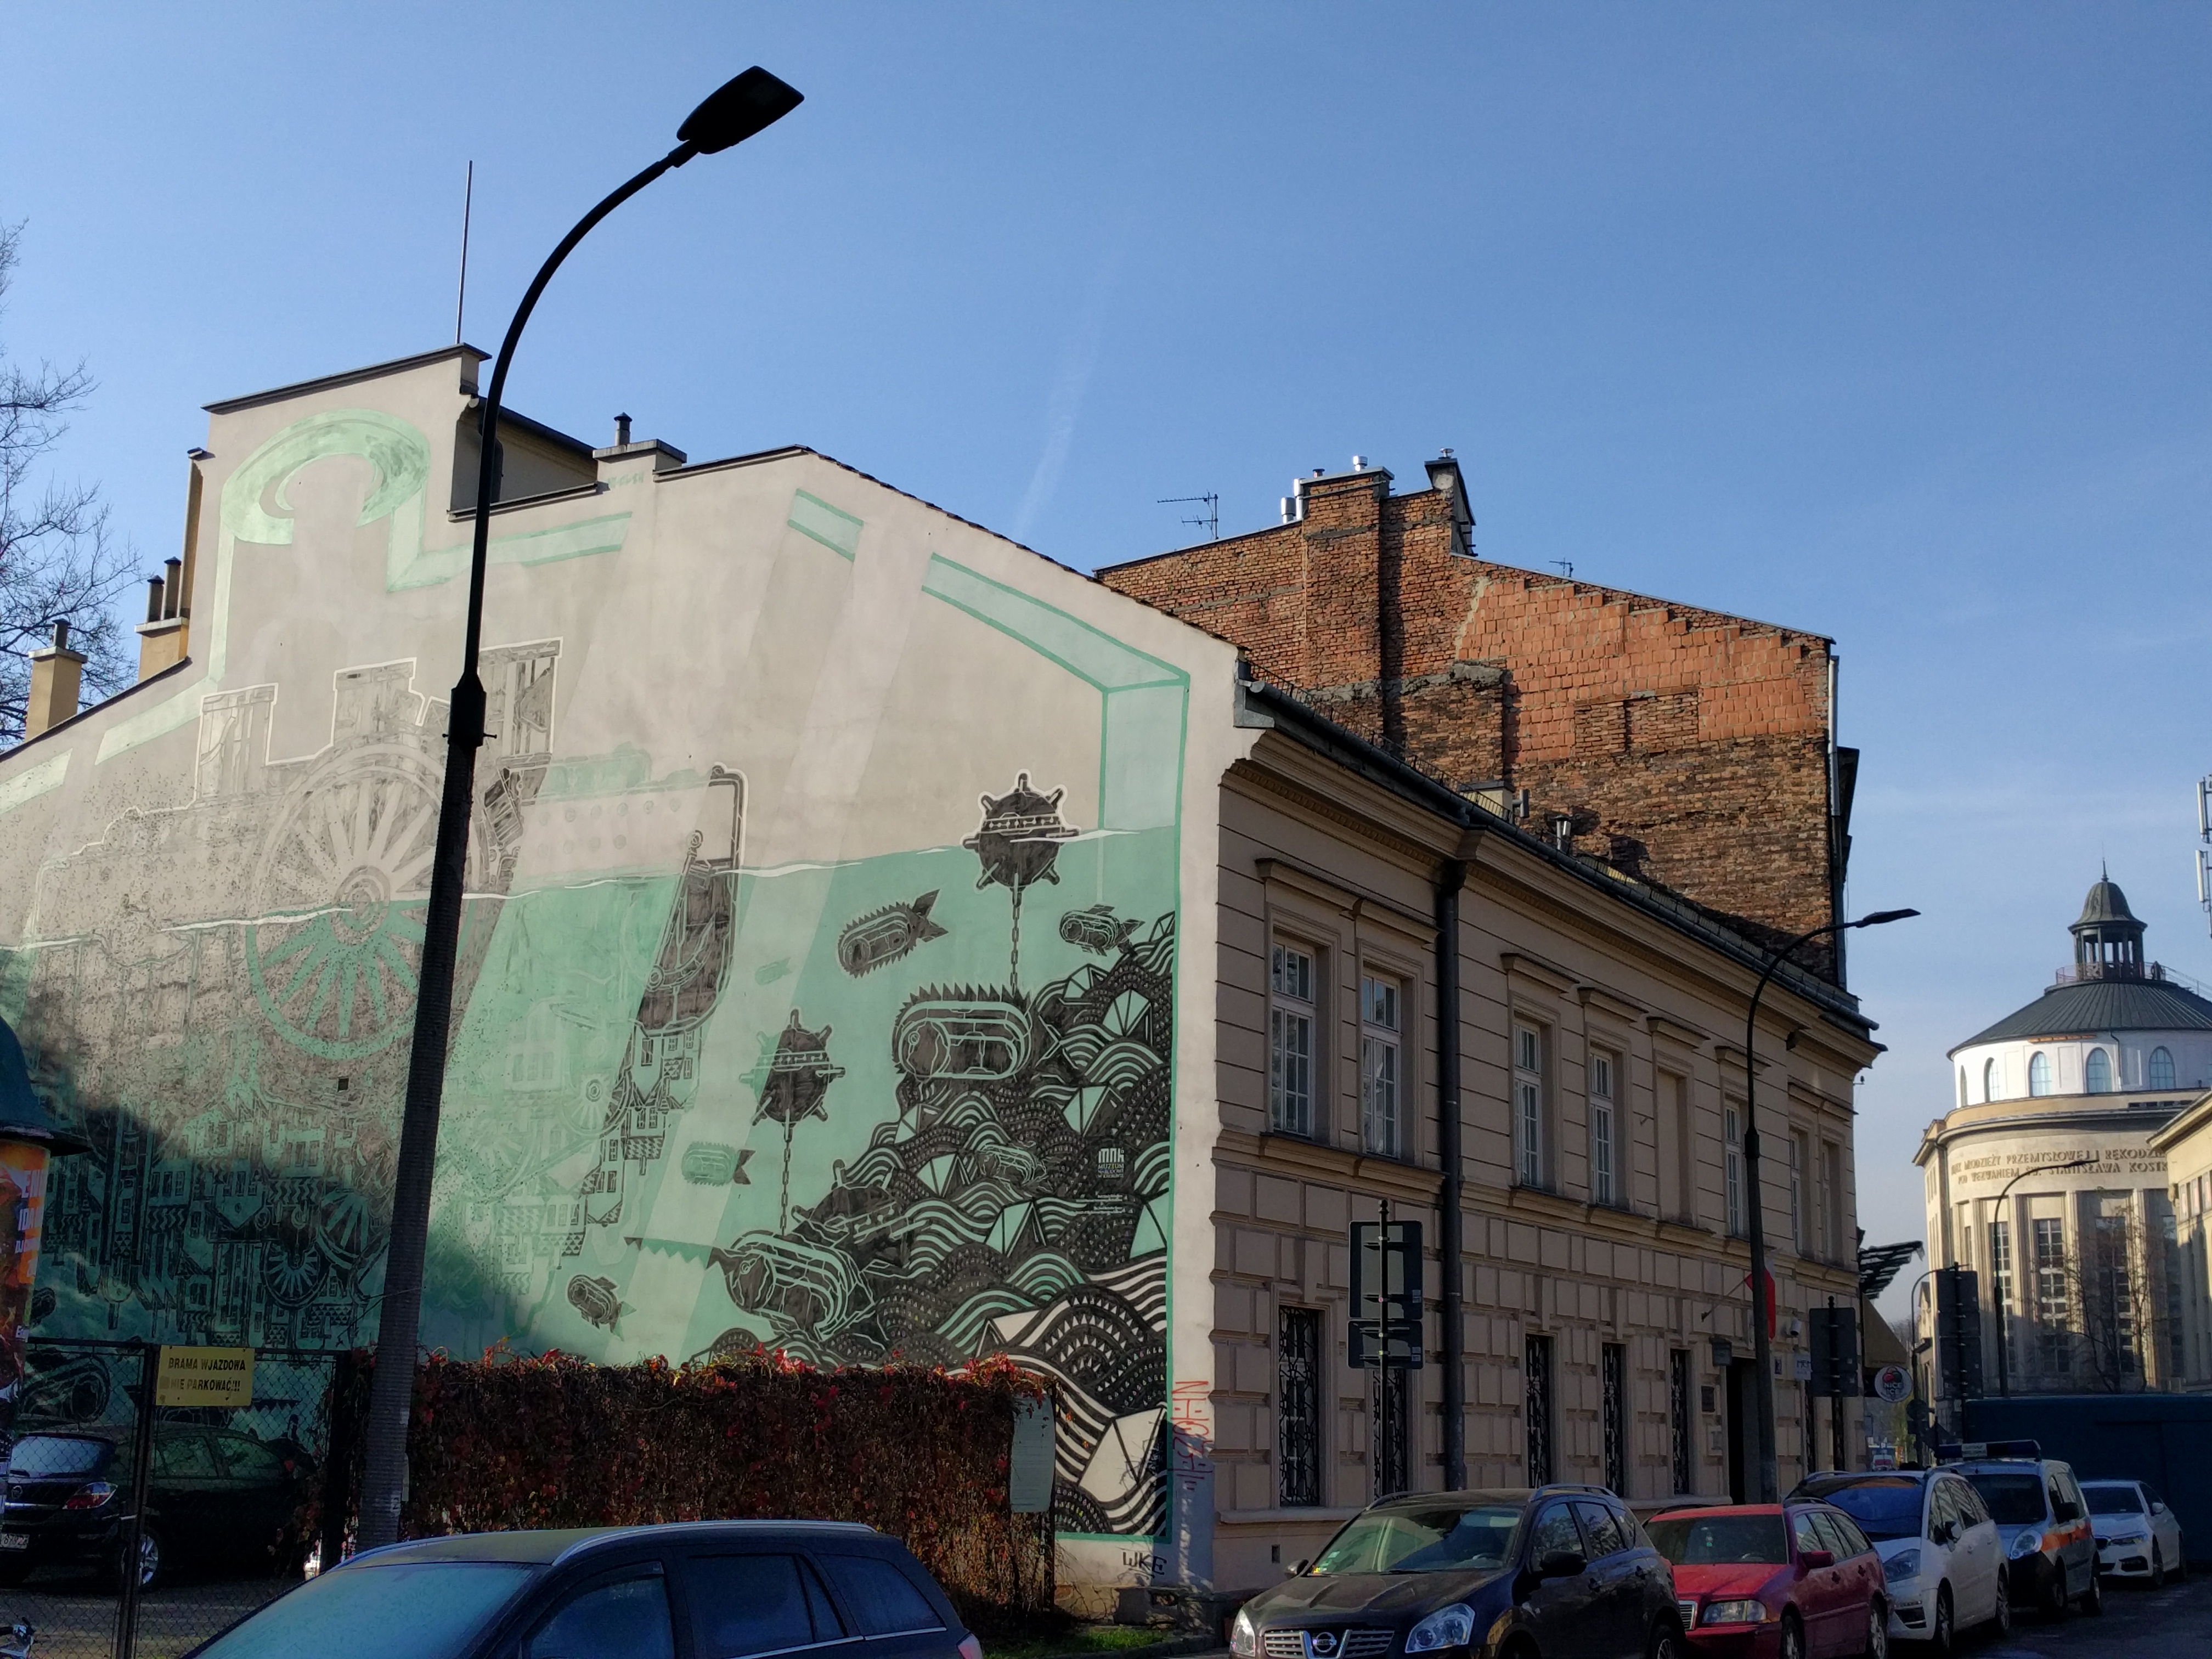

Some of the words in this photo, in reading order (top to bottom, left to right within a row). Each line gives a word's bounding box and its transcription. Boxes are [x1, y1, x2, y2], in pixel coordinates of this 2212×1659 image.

[2006, 1150, 2090, 1165] PRZEMYSŁOWEJ
[168, 1357, 198, 1369] BRAMA
[201, 1359, 246, 1370] WJAZDOWA
[171, 1378, 184, 1390] NIE
